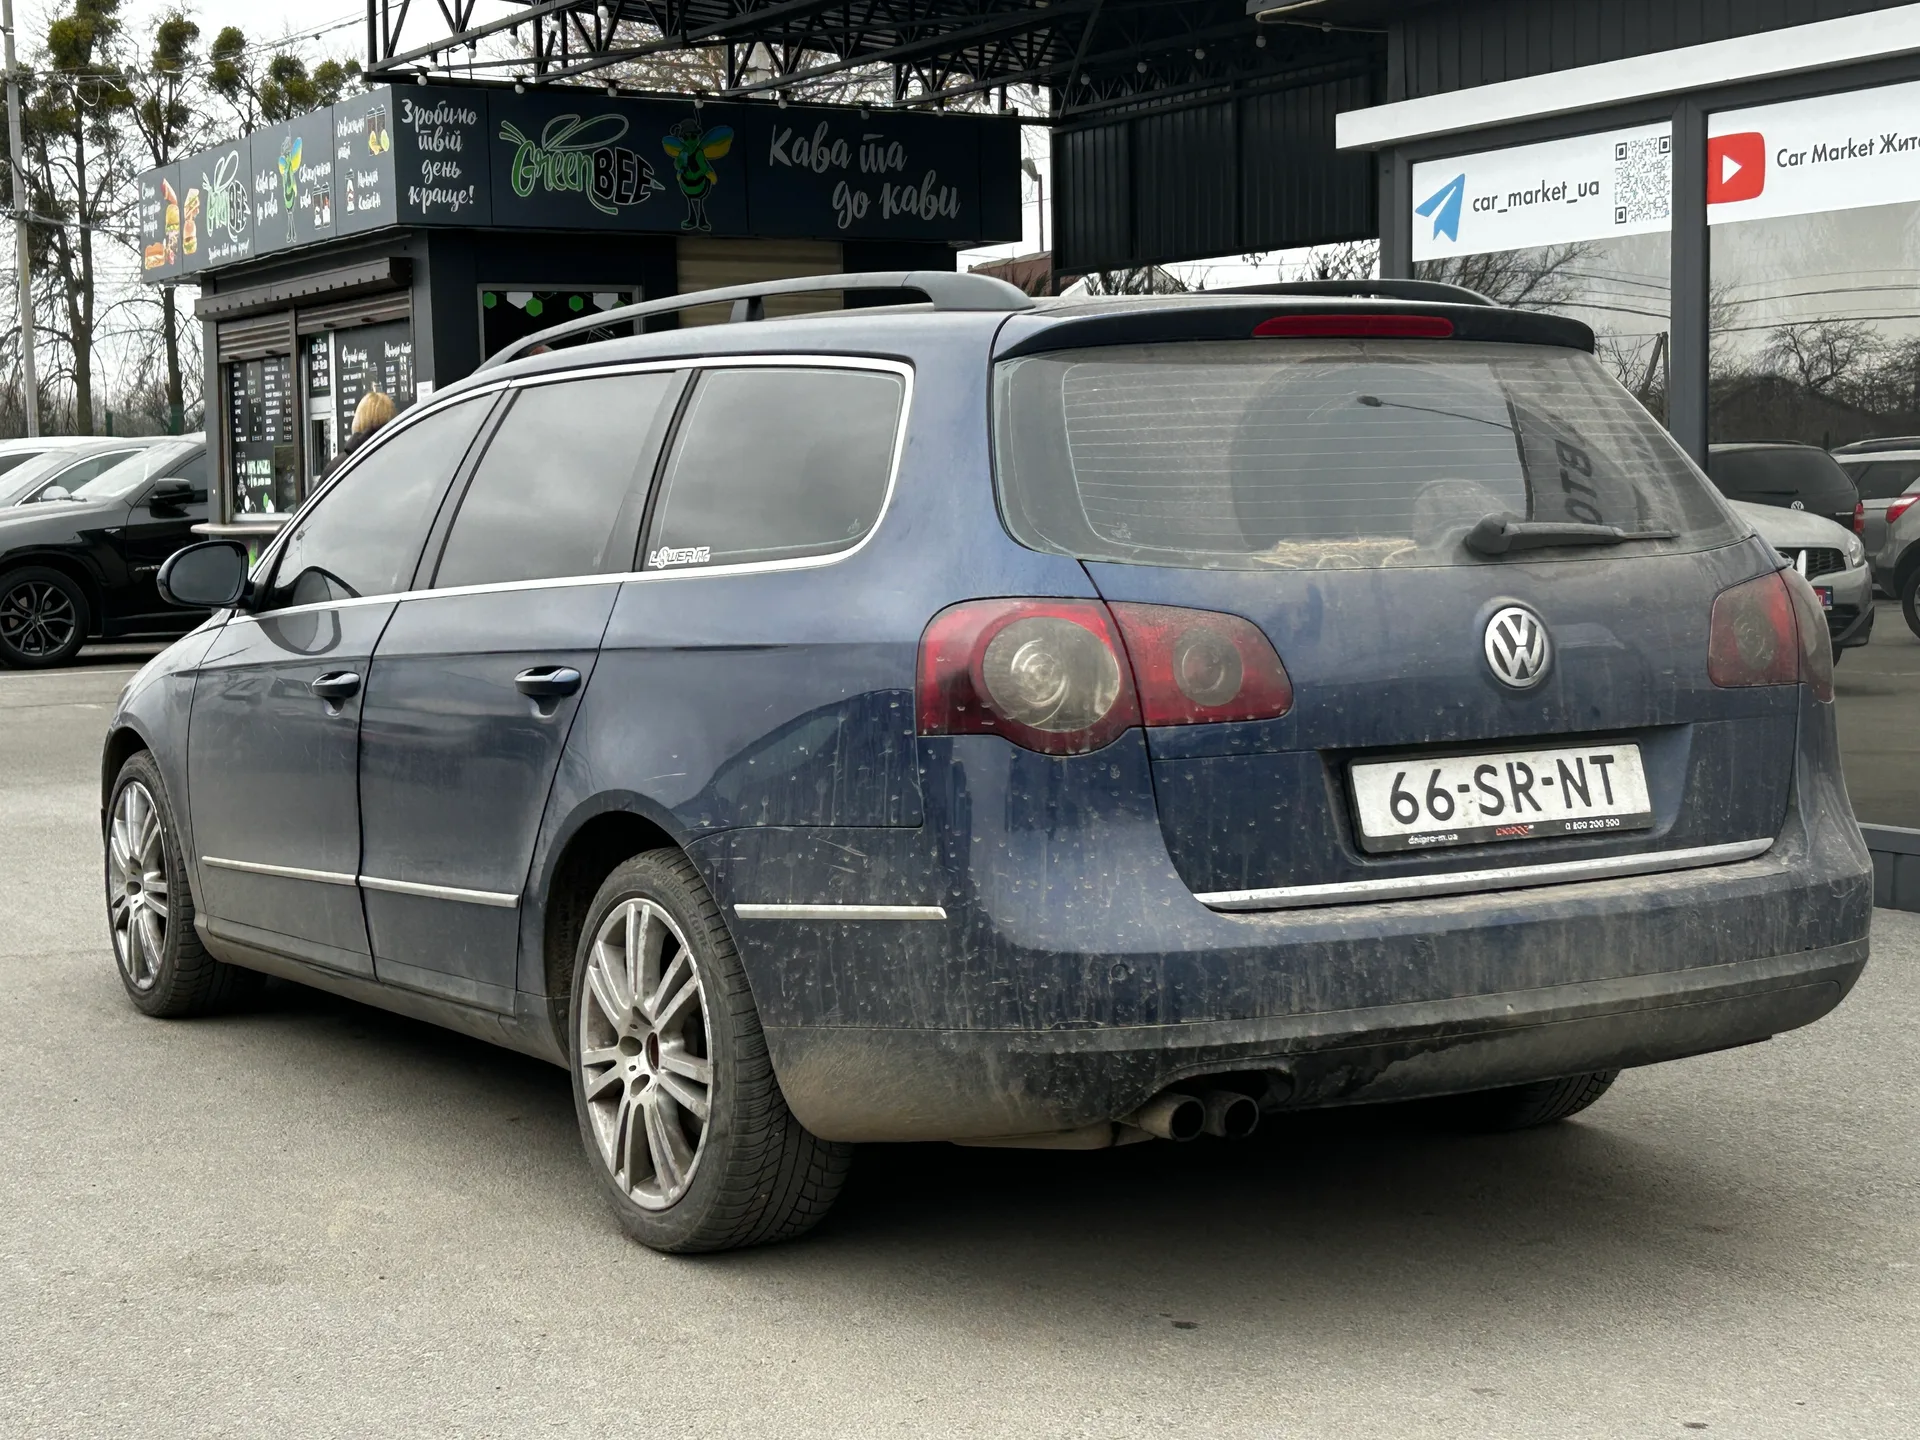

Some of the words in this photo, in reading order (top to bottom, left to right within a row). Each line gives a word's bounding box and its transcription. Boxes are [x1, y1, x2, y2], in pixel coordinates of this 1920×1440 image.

[401, 98, 478, 133] Зробимо
[418, 126, 463, 152] твій
[769, 121, 851, 173] Кава
[859, 133, 907, 173] та
[1777, 148, 1807, 168] Car
[1811, 137, 1875, 163] Market
[1879, 132, 1920, 154] Жит
[421, 158, 462, 184] день
[408, 185, 475, 214] краще!
[832, 180, 871, 229] до
[879, 170, 961, 221] кави
[1473, 179, 1600, 214] car_market_ua
[1389, 754, 1615, 825] 66-SR-NT
